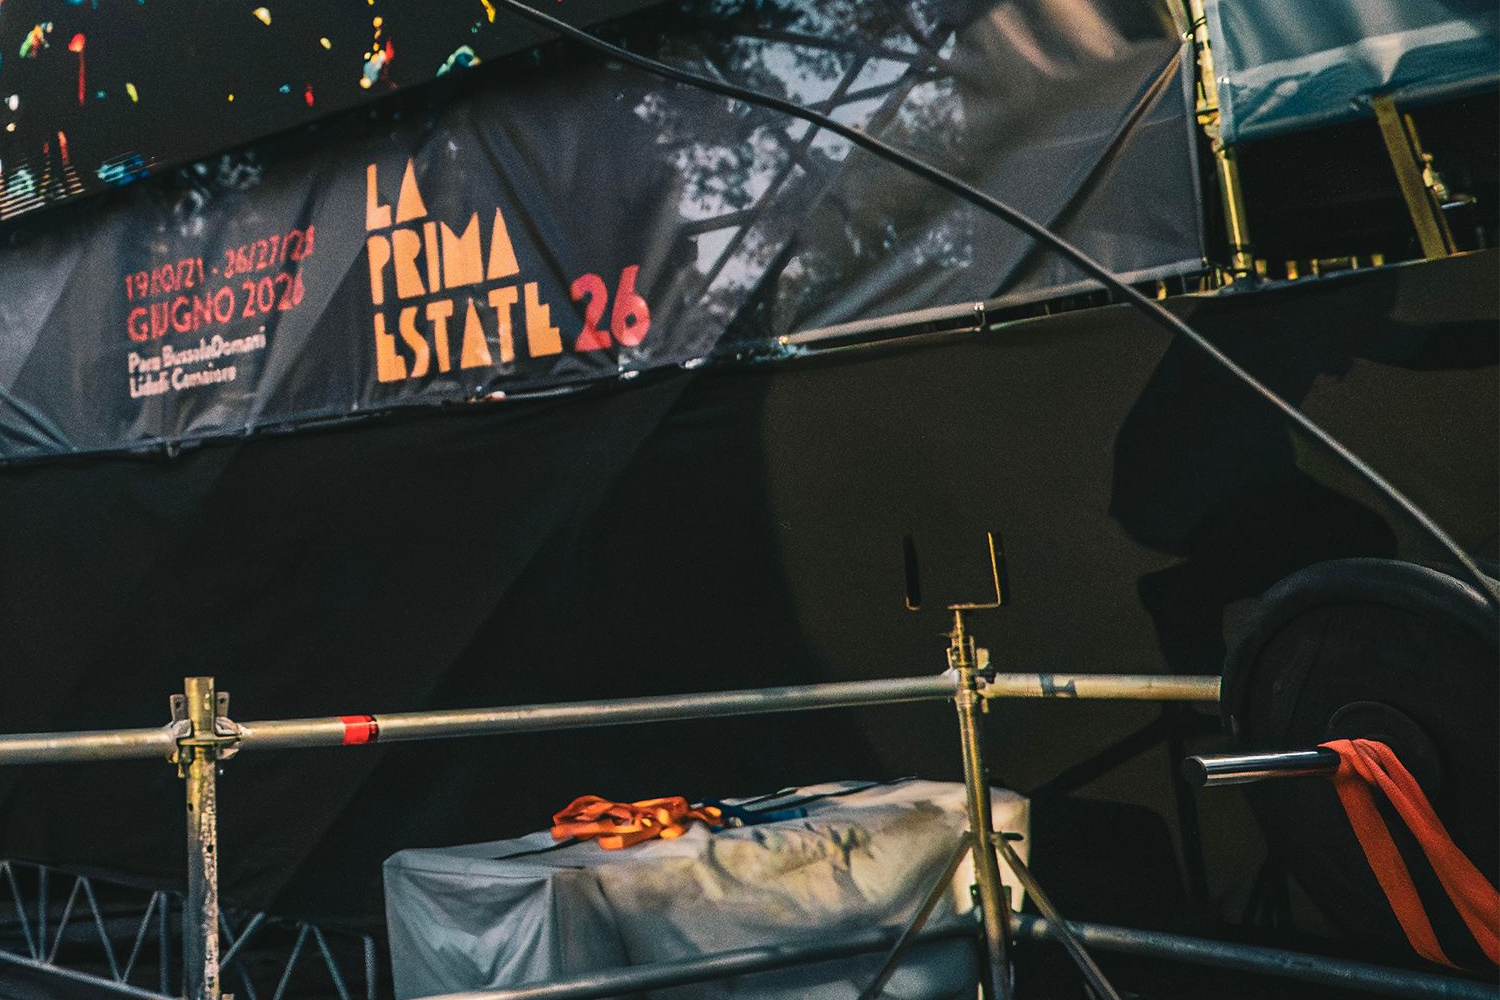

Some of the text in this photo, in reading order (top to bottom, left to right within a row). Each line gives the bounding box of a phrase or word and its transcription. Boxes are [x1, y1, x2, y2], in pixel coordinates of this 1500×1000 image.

[366, 157, 428, 231] LA
[366, 206, 520, 306] PRIMA
[126, 285, 236, 343] GIUGNO
[374, 264, 651, 383] ESTATE 26
